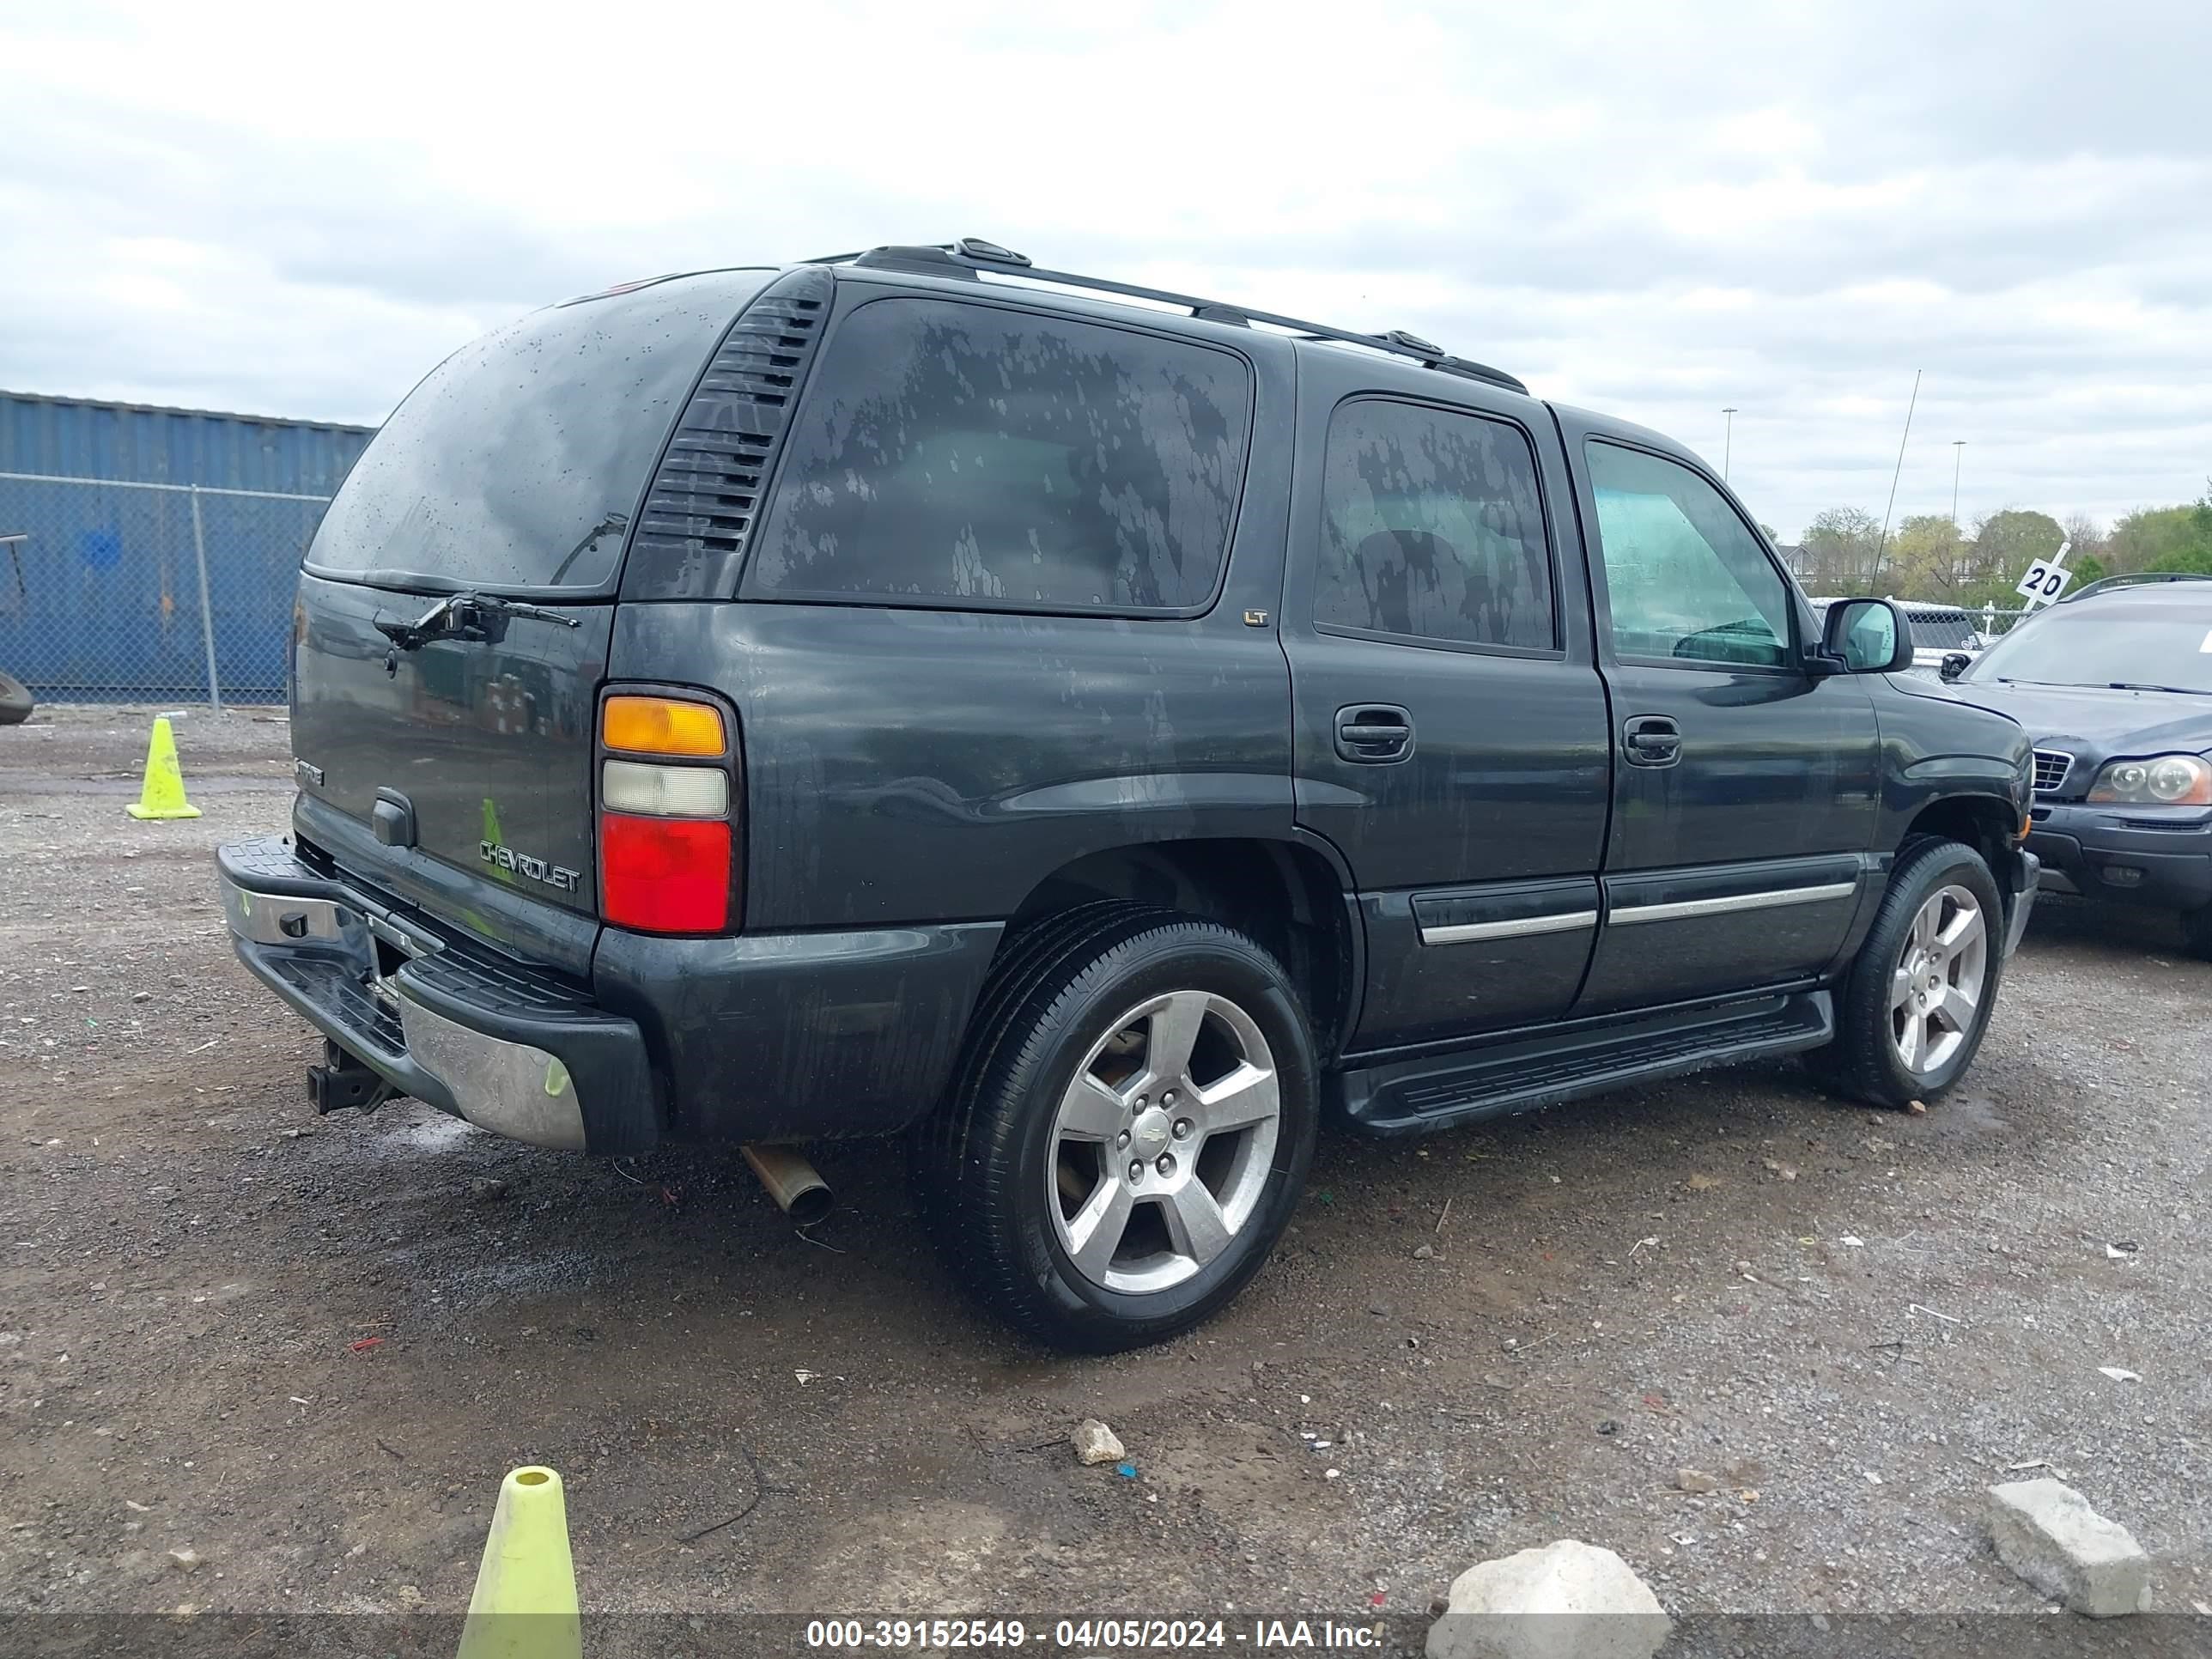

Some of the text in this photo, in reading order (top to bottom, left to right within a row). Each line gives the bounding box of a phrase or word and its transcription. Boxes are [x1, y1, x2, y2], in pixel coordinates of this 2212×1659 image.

[2024, 568, 2061, 597] 20
[1244, 611, 1267, 623] LT
[479, 839, 581, 892] CHEVROLET
